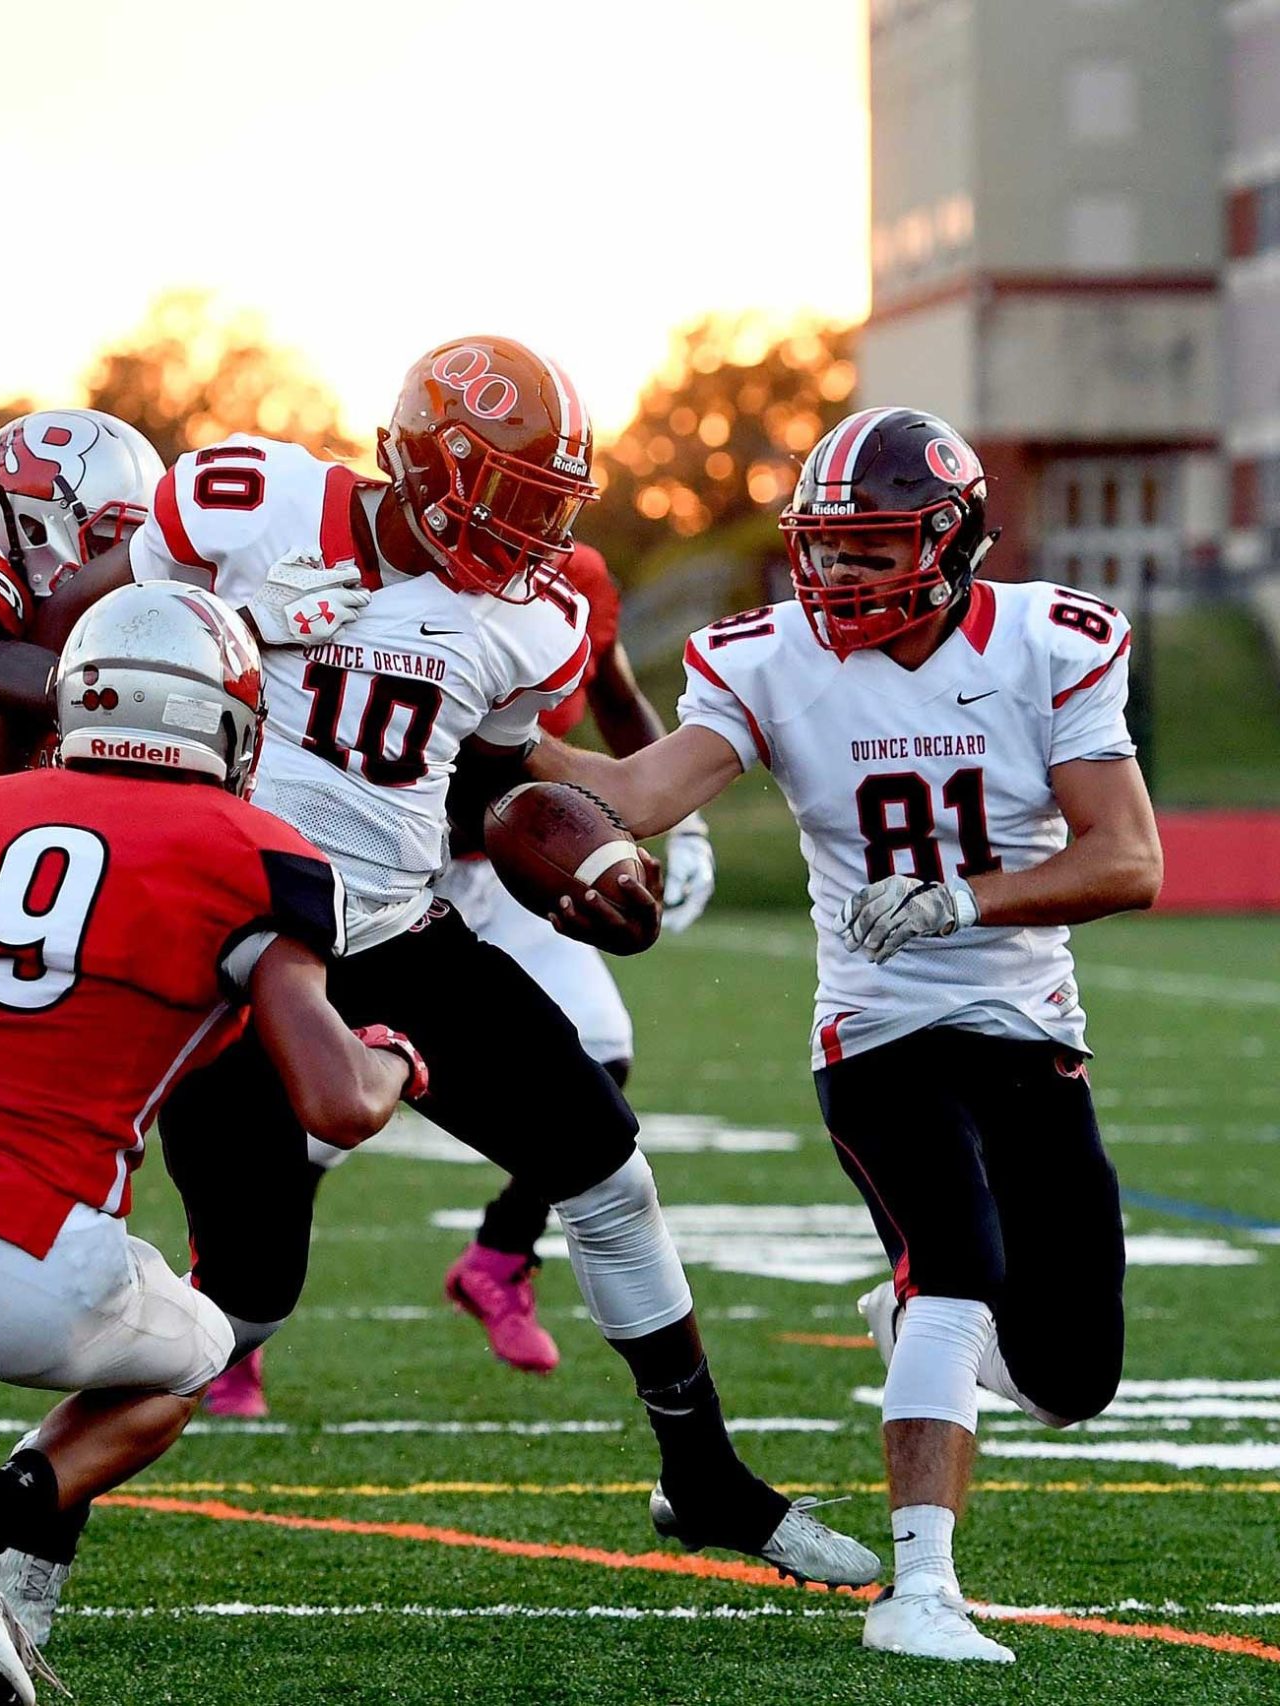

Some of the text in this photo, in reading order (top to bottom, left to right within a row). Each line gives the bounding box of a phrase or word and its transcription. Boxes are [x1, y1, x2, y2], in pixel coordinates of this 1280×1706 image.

[553, 456, 588, 478] Riddell
[812, 503, 855, 516] Riddell
[302, 642, 446, 681] QUINCE ORCHARD
[301, 661, 443, 788] 10
[851, 735, 986, 762] QUINCE ORCHARD
[856, 768, 1004, 884] 81
